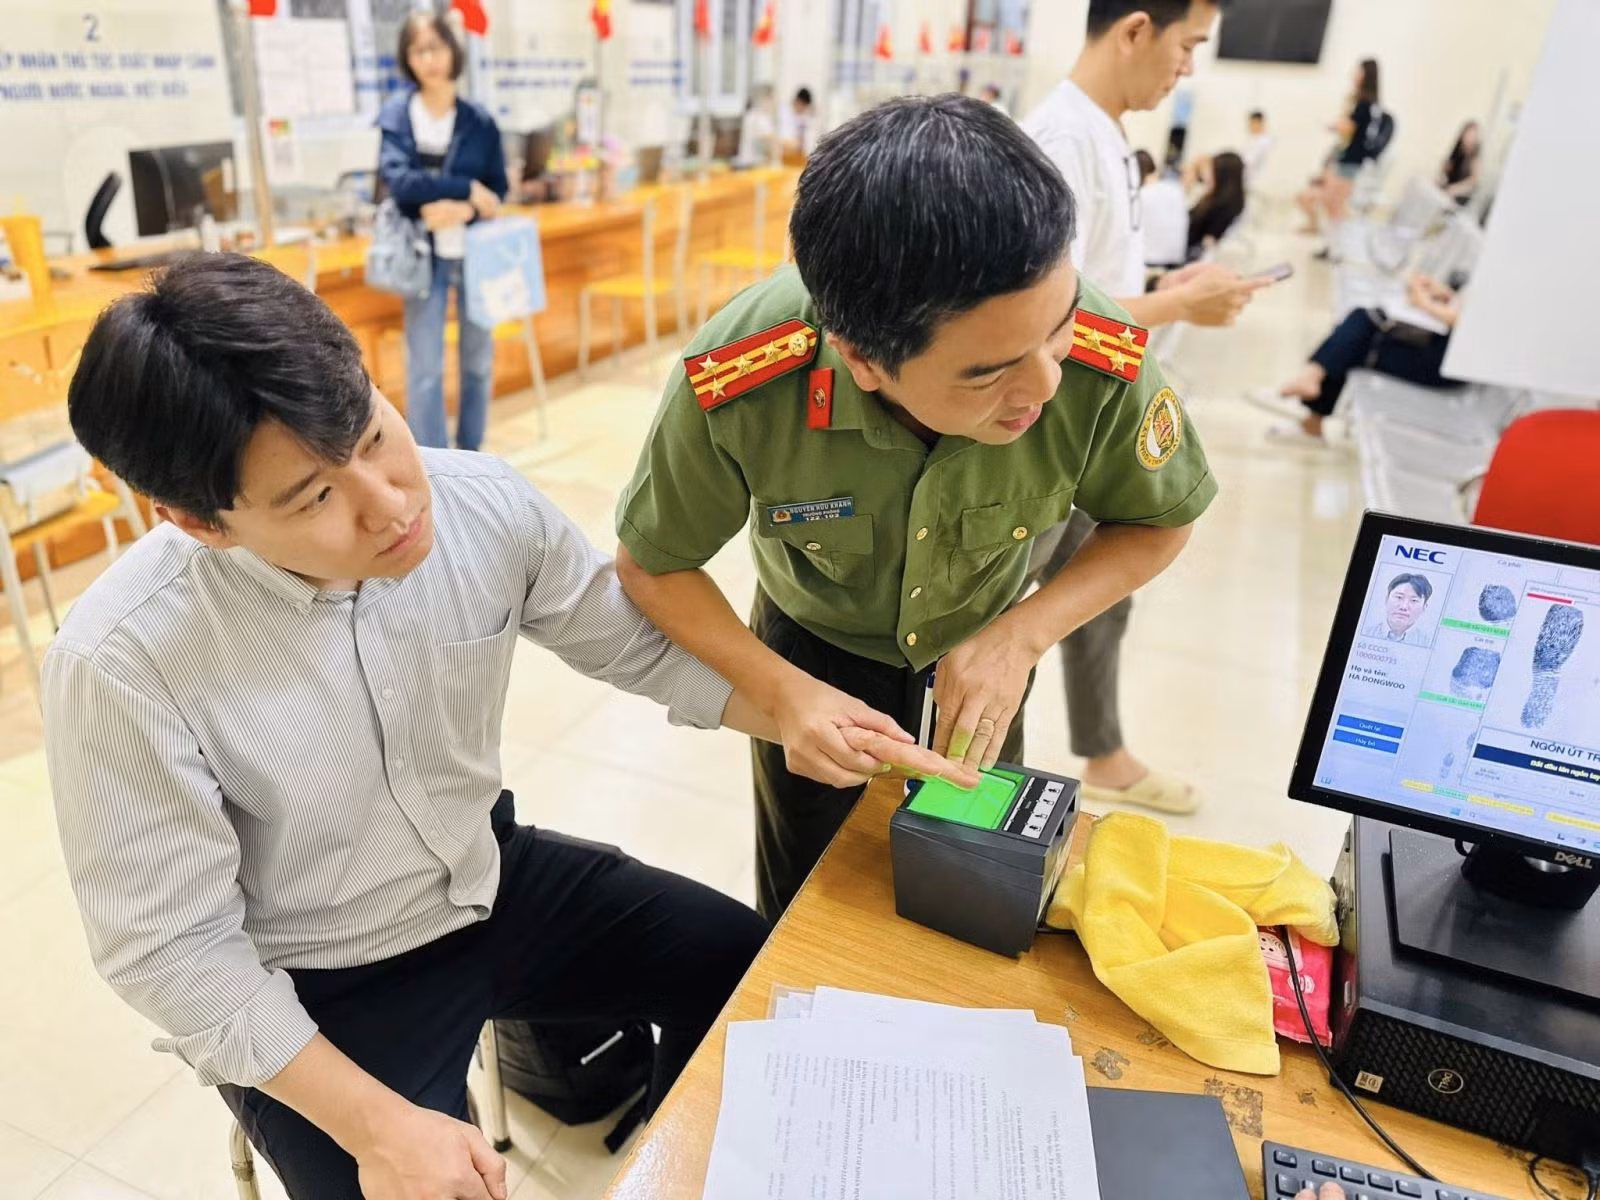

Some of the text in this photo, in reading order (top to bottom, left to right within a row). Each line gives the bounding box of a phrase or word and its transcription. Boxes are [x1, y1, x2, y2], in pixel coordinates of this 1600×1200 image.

[83, 13, 100, 42] 2
[1395, 545, 1447, 565] NEC
[1348, 673, 1405, 690] HA DONGWOO
[1555, 852, 1592, 869] DELL
